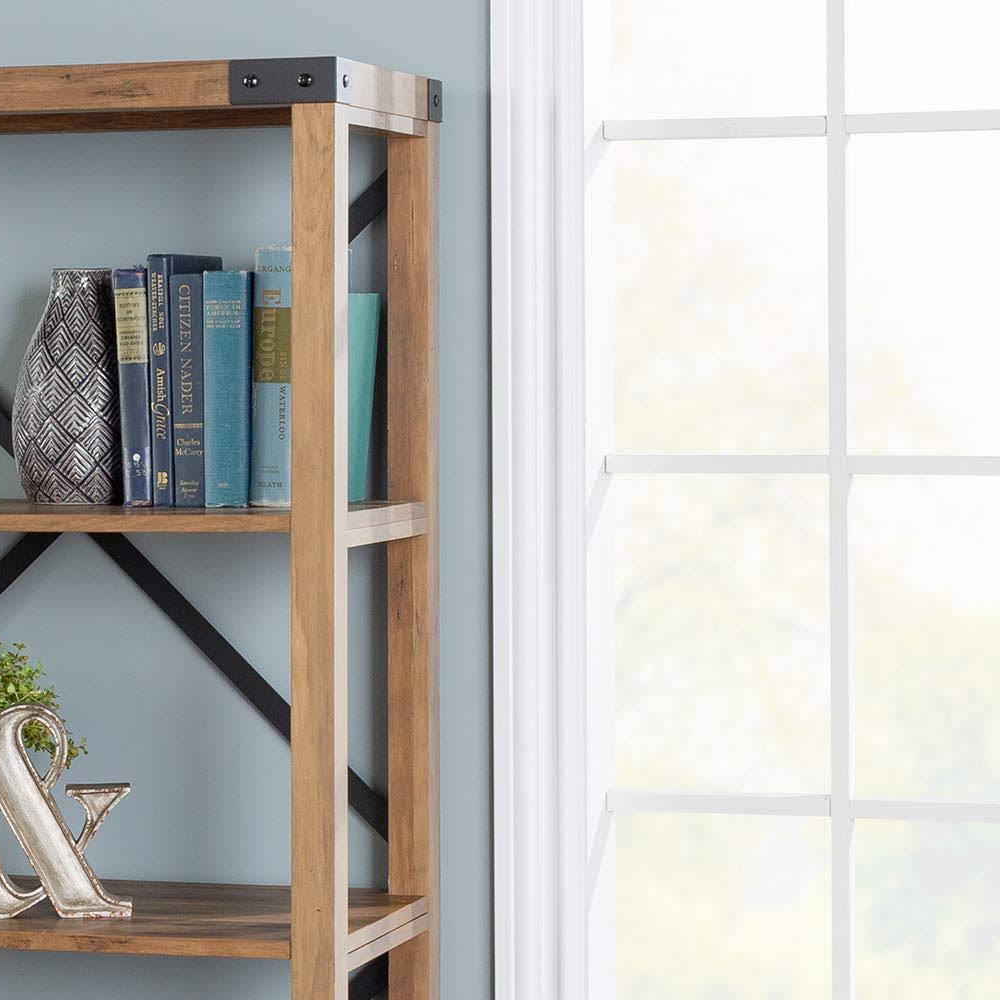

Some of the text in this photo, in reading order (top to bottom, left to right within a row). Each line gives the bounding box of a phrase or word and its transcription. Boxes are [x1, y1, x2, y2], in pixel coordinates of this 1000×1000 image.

[179, 284, 193, 415] CITIZEN NADER
[260, 288, 281, 381] Europe
[151, 368, 170, 440] Amish Grace
[279, 385, 287, 441] WATERLOO
[175, 448, 204, 457] McCarry
[176, 438, 201, 446] Charles
